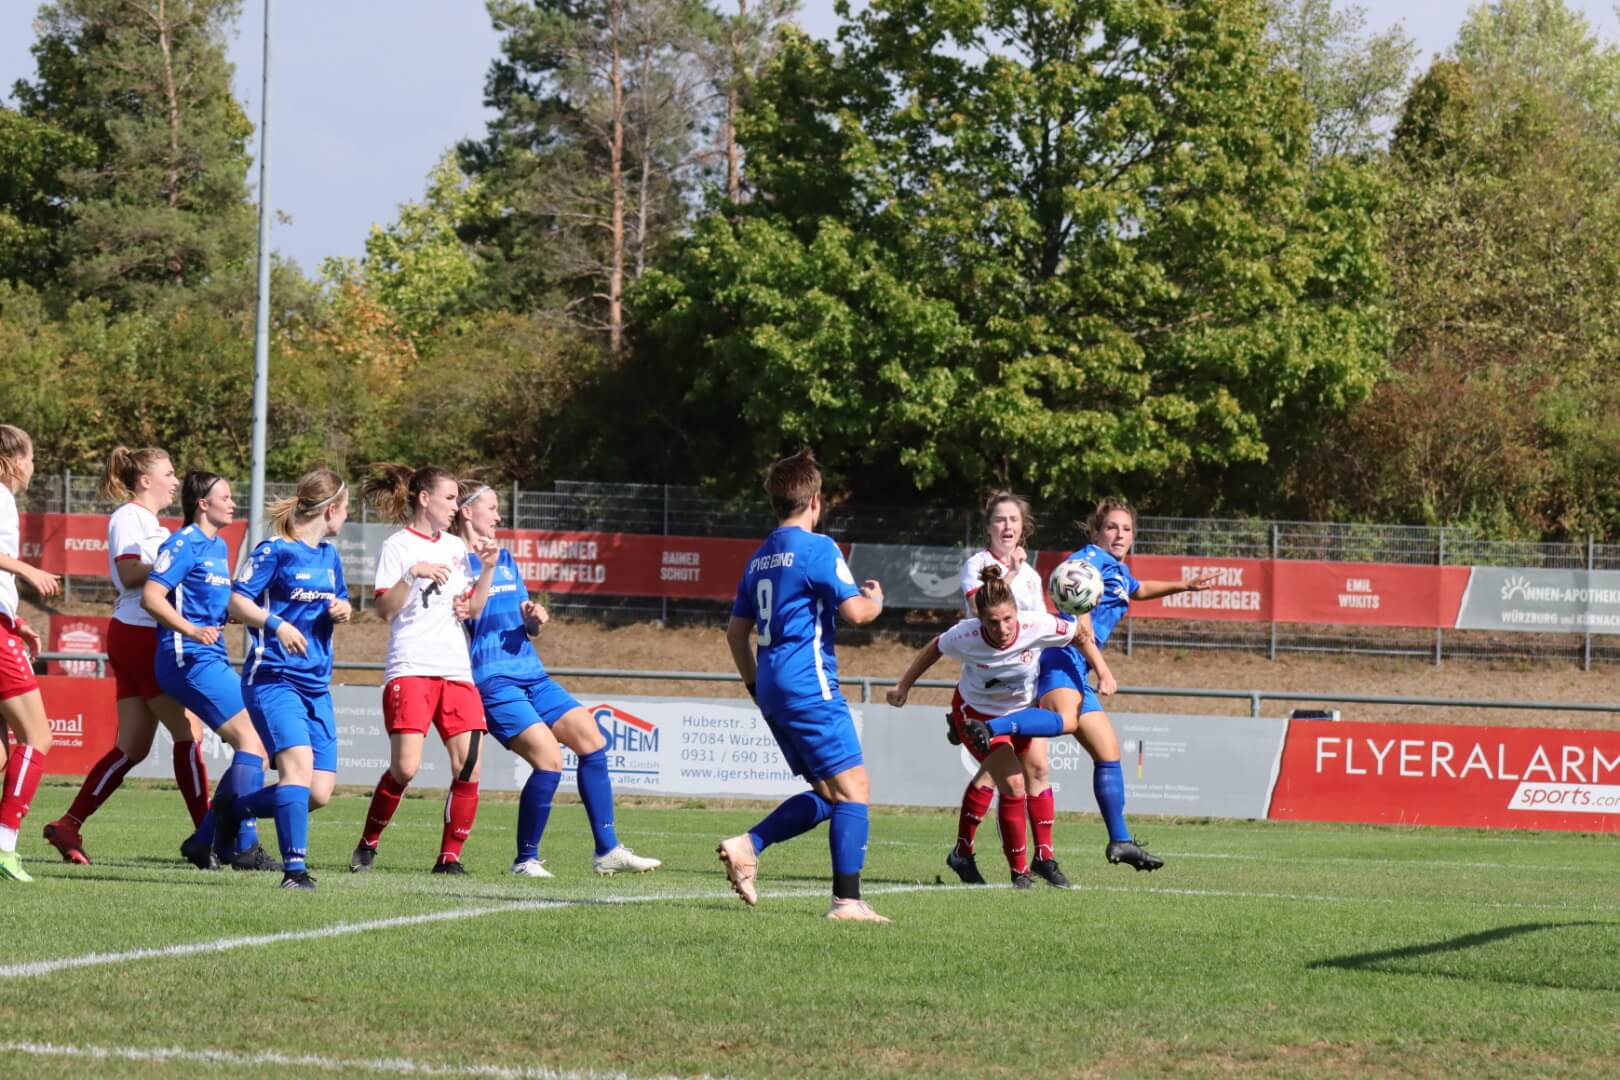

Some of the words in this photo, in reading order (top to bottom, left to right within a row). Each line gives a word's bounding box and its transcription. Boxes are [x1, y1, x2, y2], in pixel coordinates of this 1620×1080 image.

[536, 541, 597, 560] WAGNER
[662, 552, 700, 565] RAINER
[660, 567, 700, 581] SCHOTT
[1346, 579, 1372, 592] EMIL
[1338, 594, 1380, 609] WUKITS
[756, 578, 773, 646] 9
[682, 715, 744, 729] Huberstr.
[749, 717, 757, 729] 3
[682, 732, 725, 745] 97084
[681, 748, 715, 762] 0931
[732, 750, 758, 763] 690
[763, 751, 779, 764] 35
[1316, 737, 1620, 784] FLYERALARM
[618, 775, 642, 785] aller
[645, 776, 660, 785] Art
